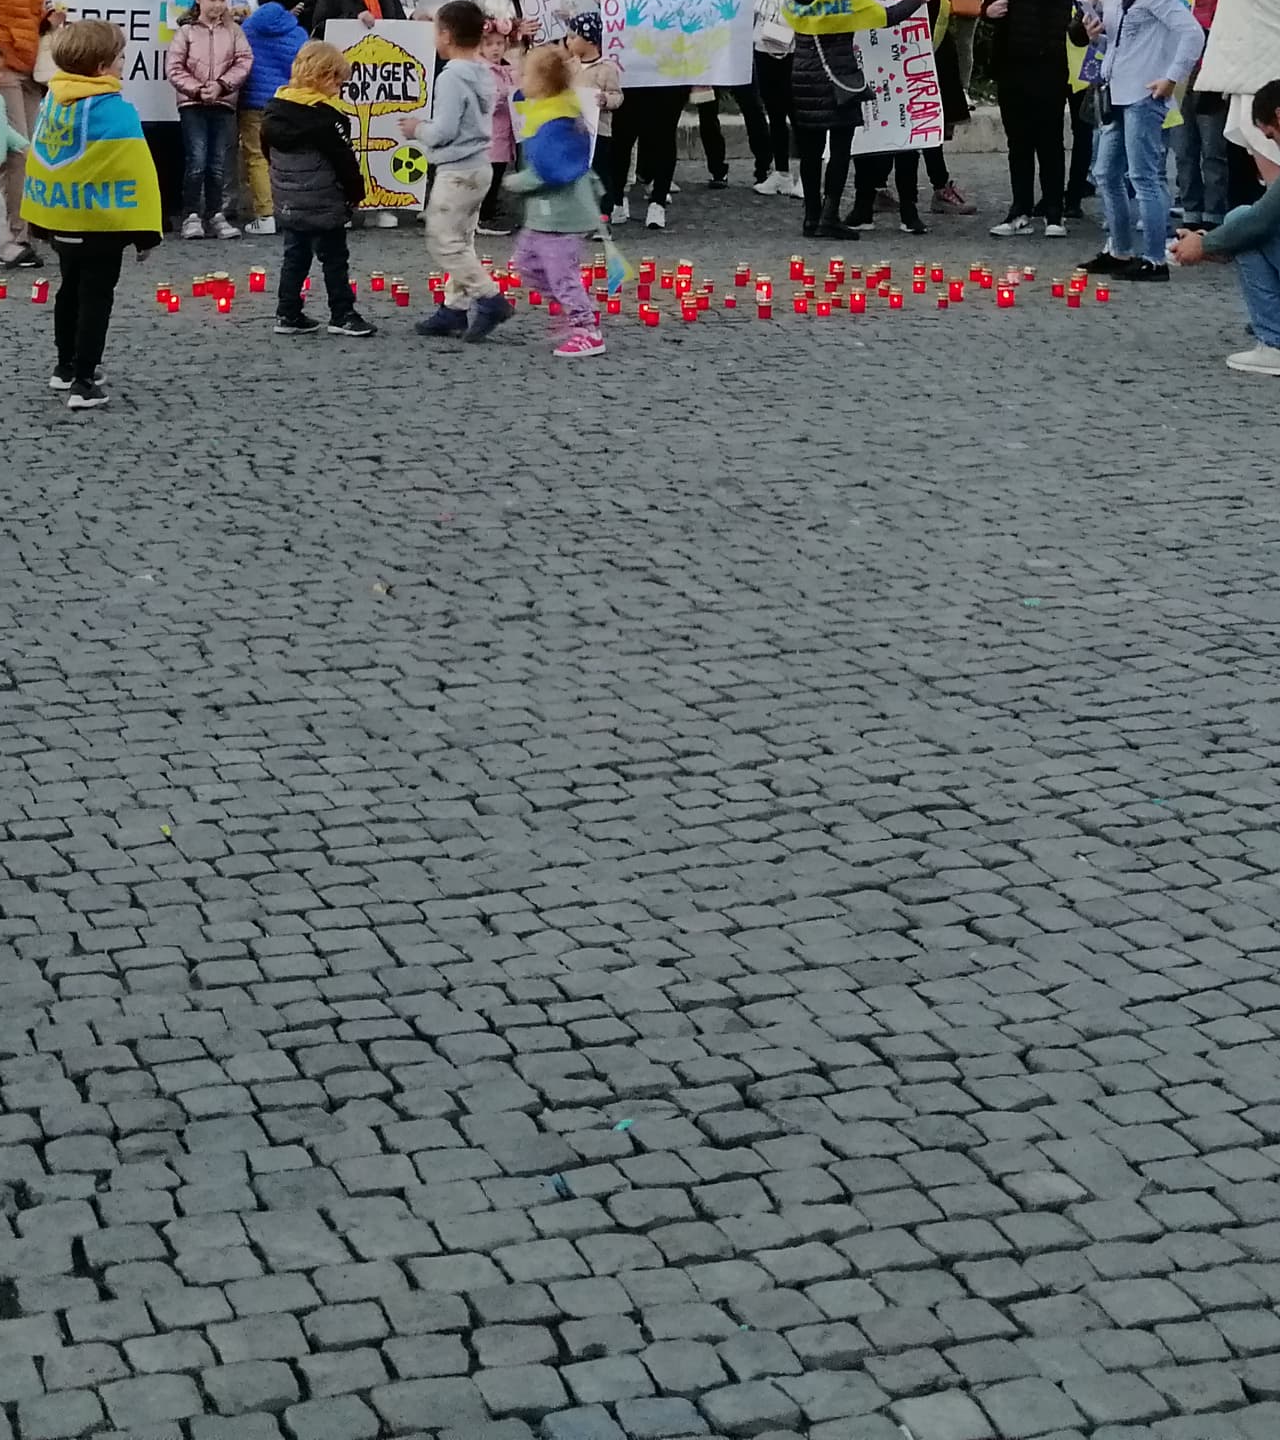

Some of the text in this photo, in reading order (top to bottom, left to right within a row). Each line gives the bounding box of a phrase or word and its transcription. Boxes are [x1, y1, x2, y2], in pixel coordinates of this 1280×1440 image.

[350, 62, 417, 82] ANGER
[340, 80, 419, 101] FOR ALL
